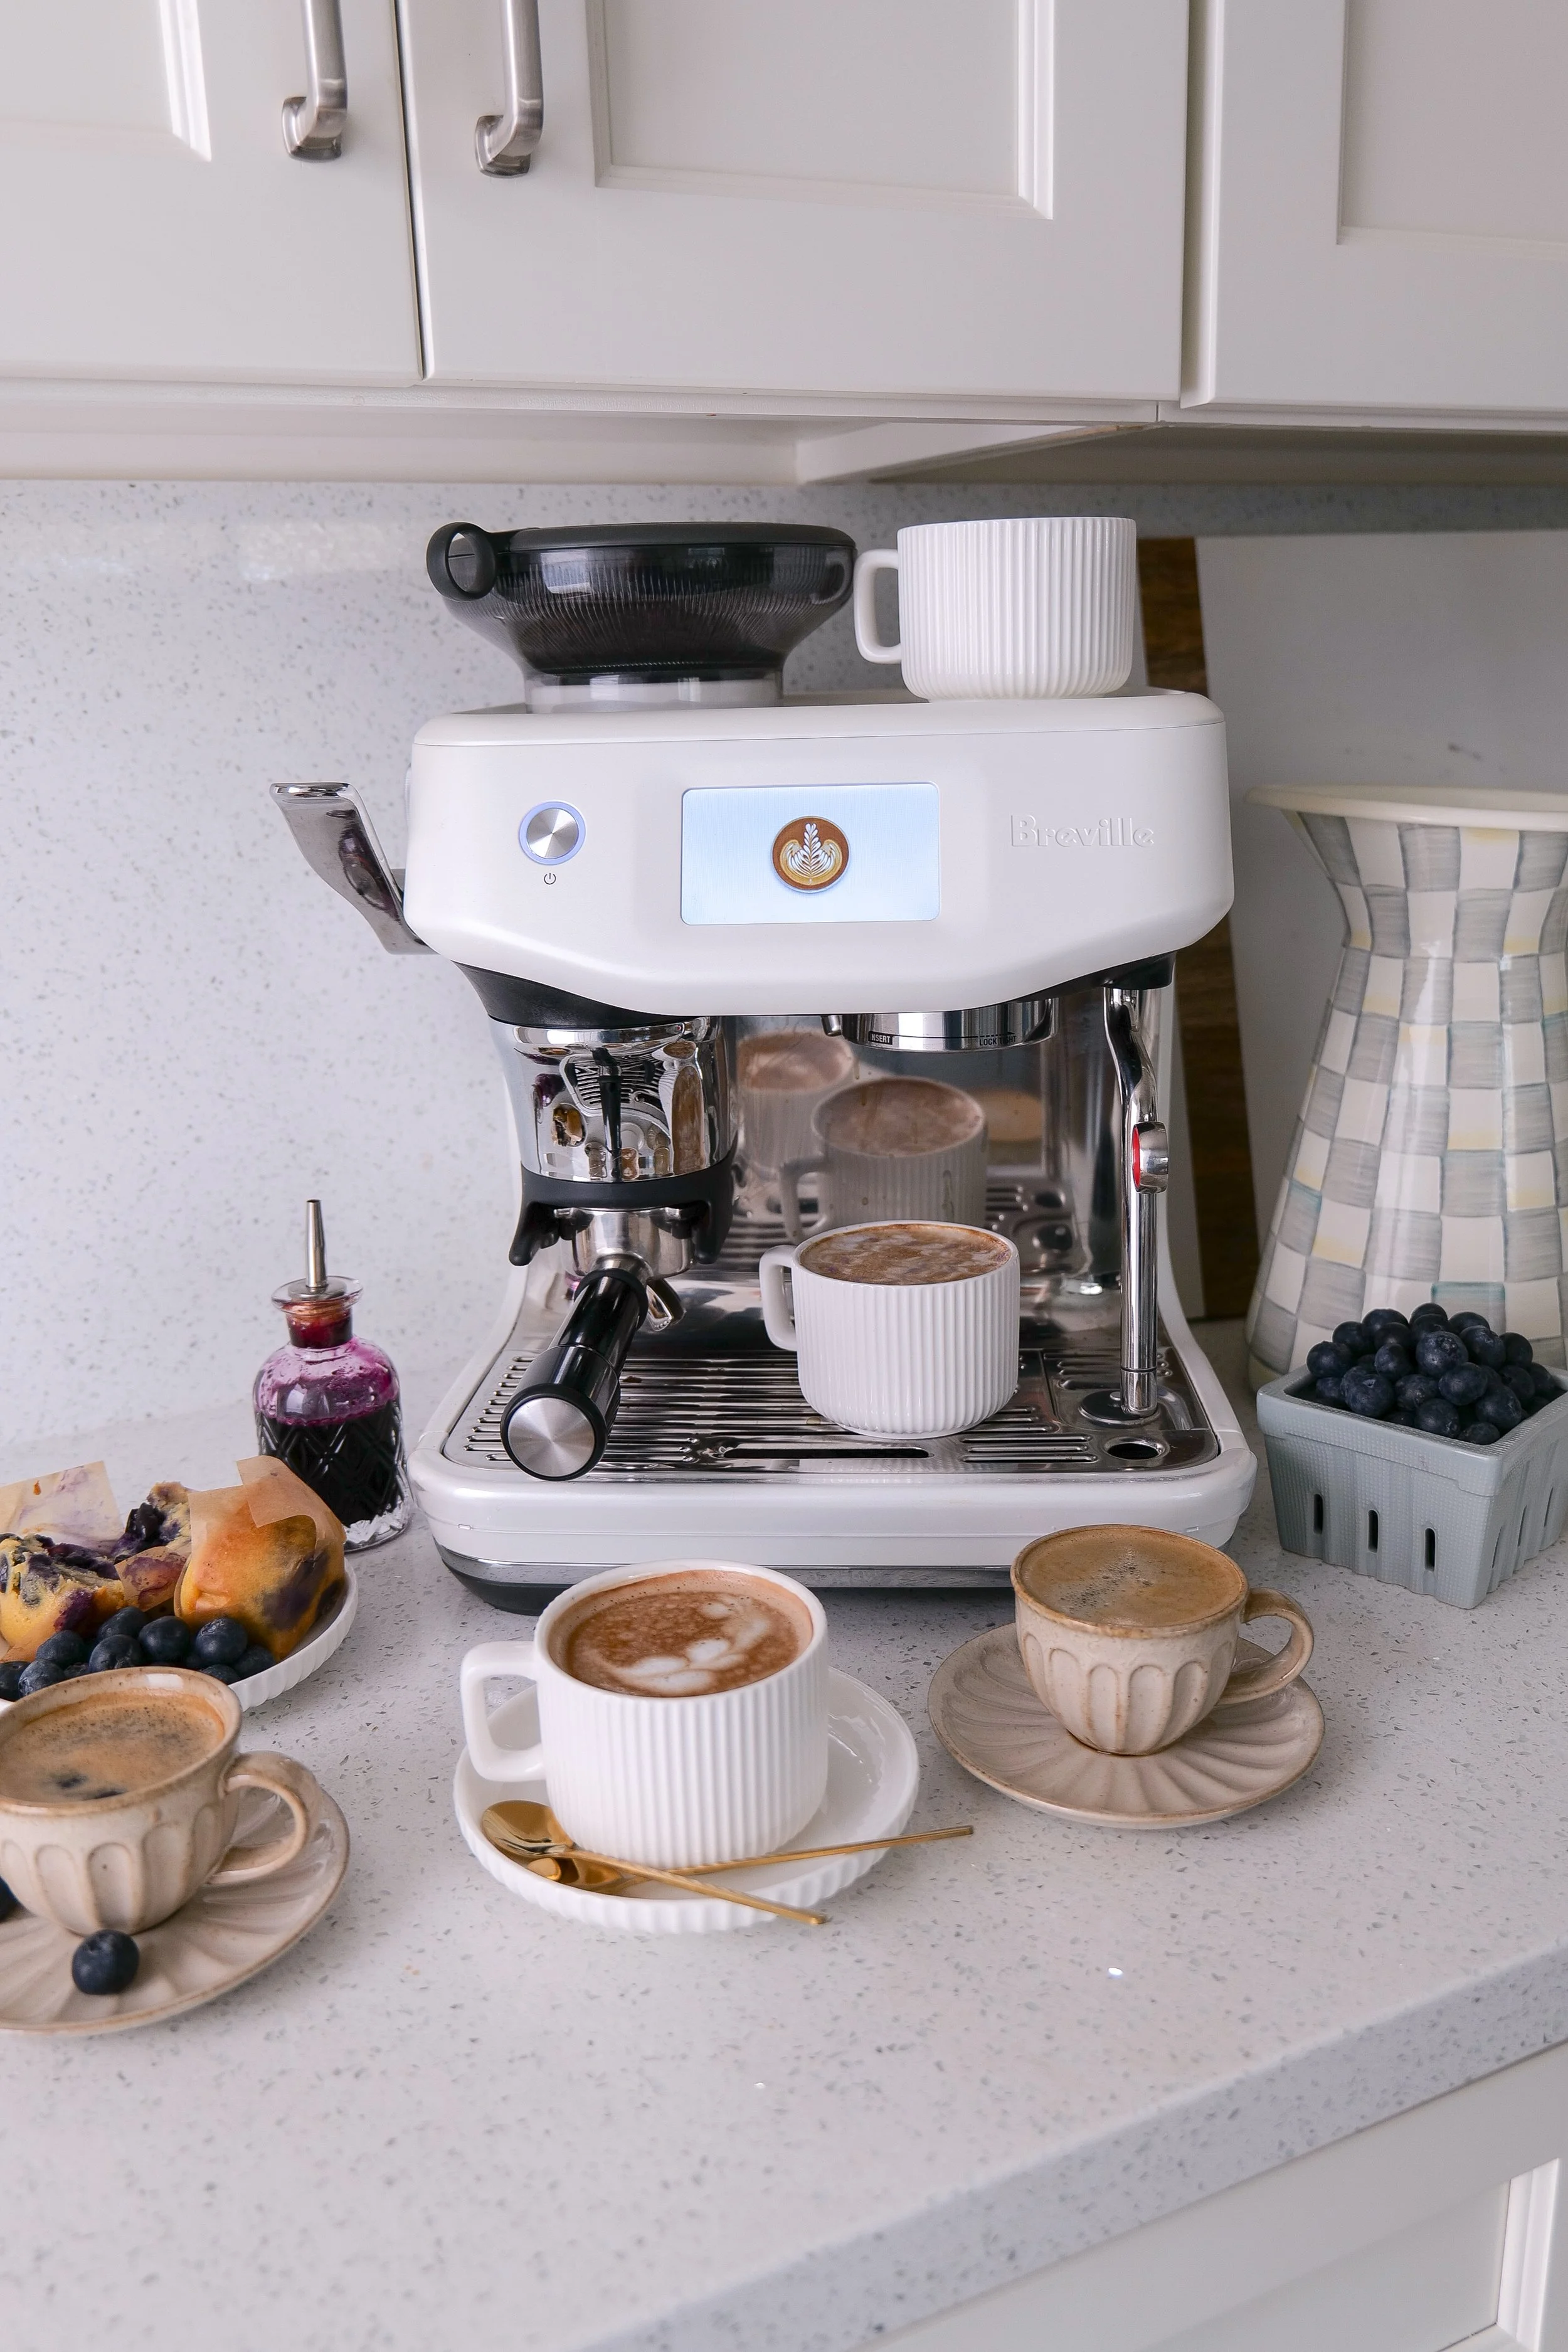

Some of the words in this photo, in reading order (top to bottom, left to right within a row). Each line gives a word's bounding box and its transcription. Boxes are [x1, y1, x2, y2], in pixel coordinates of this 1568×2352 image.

[1010, 815, 1155, 847] Breville
[979, 1037, 997, 1046] LOCK
[999, 1035, 1017, 1045] TGHT
